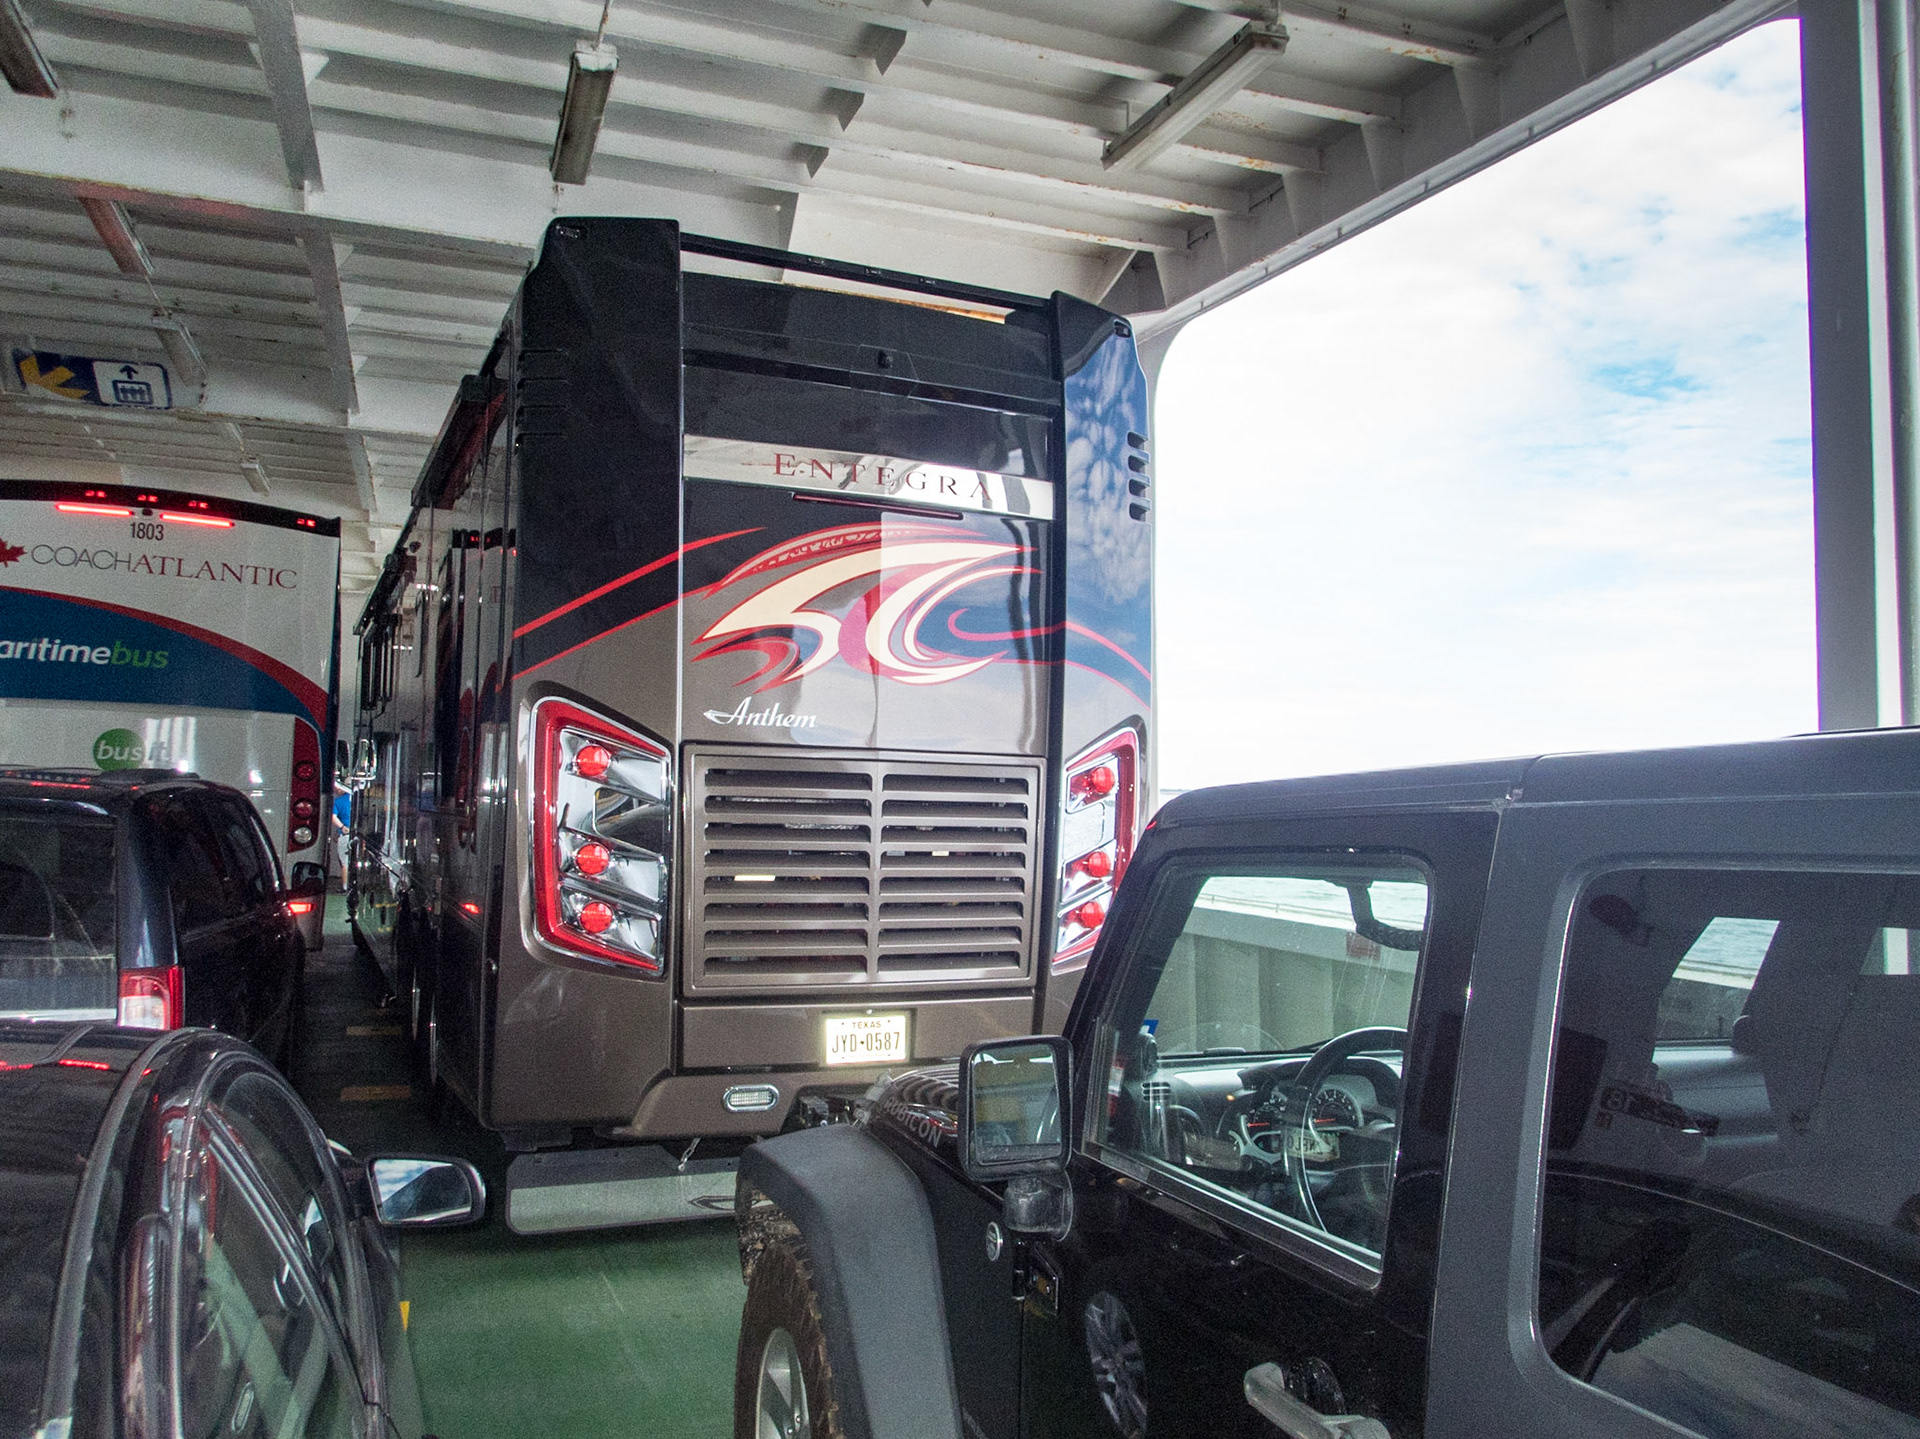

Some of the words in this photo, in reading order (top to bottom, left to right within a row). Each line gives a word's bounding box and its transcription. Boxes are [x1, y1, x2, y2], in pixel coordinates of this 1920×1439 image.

[773, 452, 993, 501] ENTEGRA
[130, 522, 164, 541] 1803
[703, 696, 816, 728] Anthem
[852, 1021, 882, 1029] TEXAS
[883, 1097, 942, 1148] RUBICON
